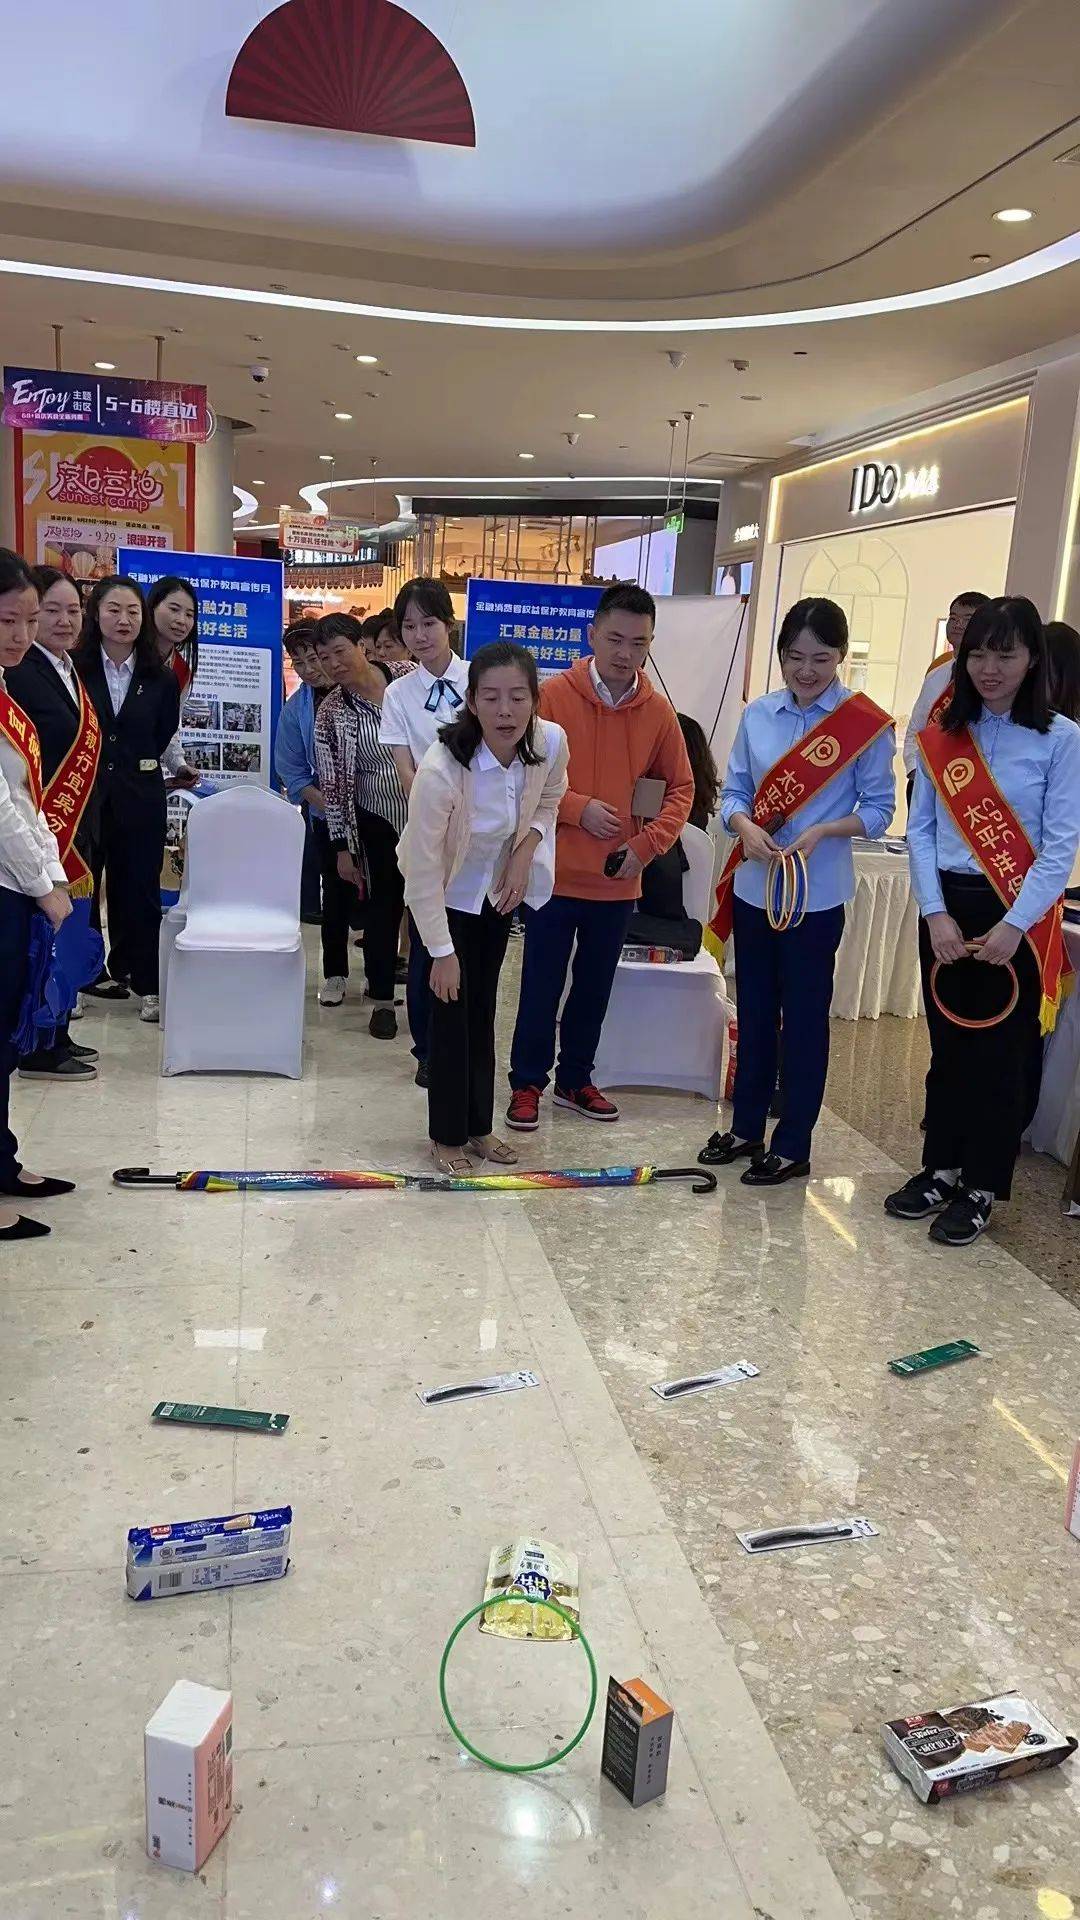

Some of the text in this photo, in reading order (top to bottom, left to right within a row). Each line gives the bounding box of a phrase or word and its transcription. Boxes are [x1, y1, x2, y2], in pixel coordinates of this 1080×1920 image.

[73, 390, 92, 401] 主题
[73, 401, 92, 412] 街区
[105, 397, 197, 420] 5-6楼直达
[49, 461, 163, 500] 落日营地
[59, 491, 149, 511] sunset camp
[126, 533, 167, 548] 浪漫开营
[127, 572, 271, 594] 金融消益保护教育宣传月
[198, 600, 248, 618] 融力量
[499, 623, 582, 642] 汇聚金融力量
[522, 645, 581, 661] 美好生活
[754, 769, 797, 820] 太平洋
[981, 797, 1016, 844] CPIC
